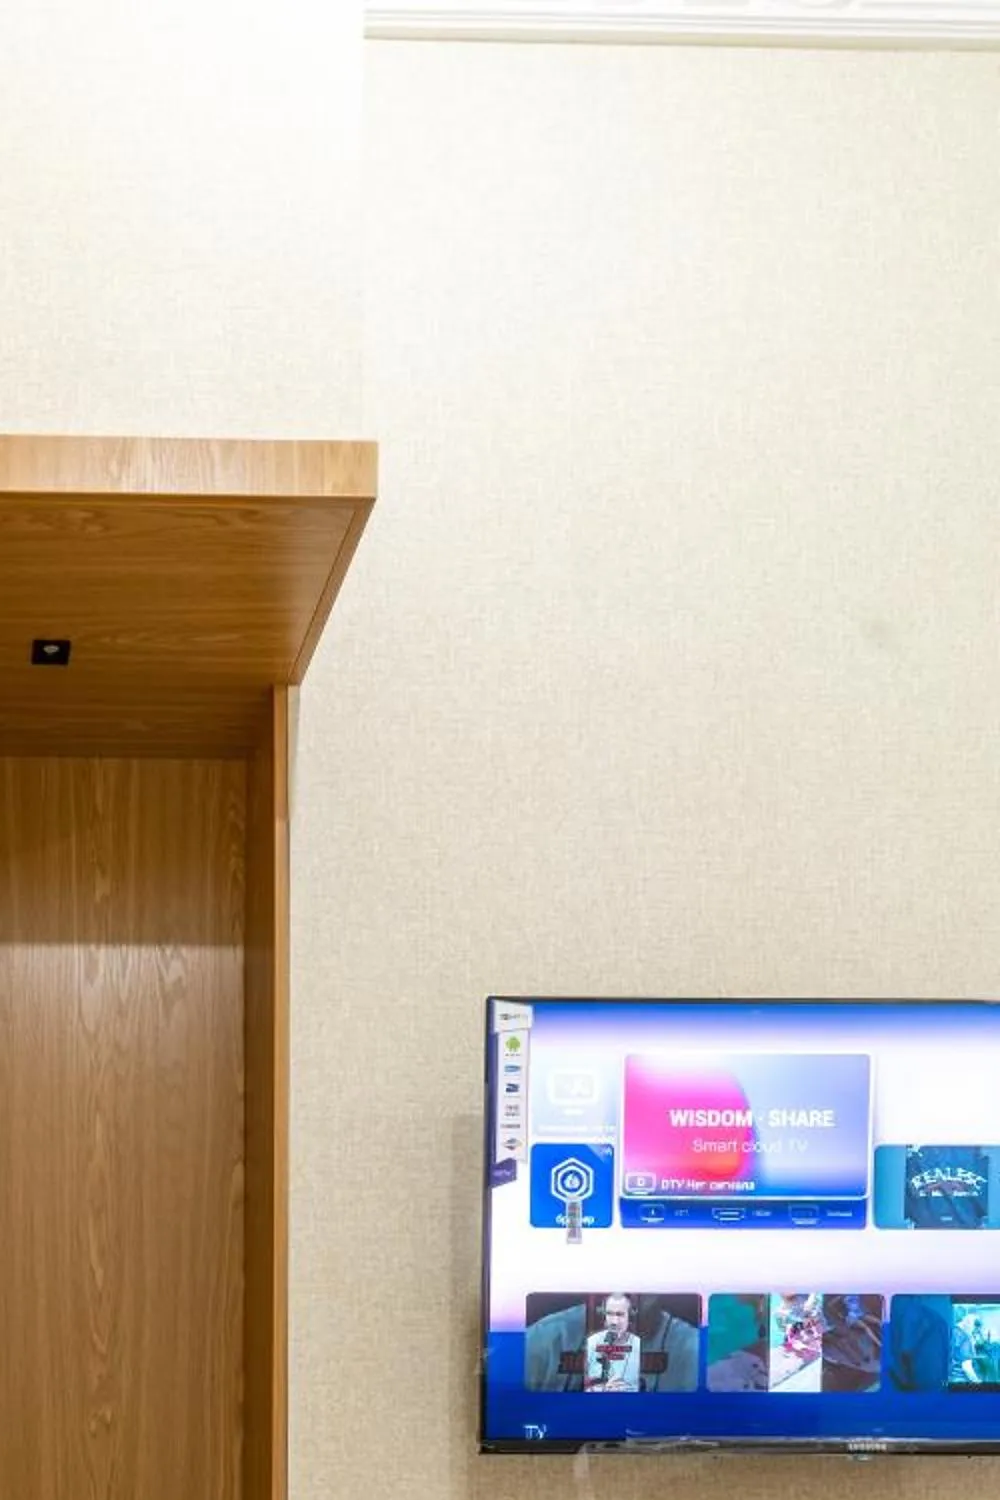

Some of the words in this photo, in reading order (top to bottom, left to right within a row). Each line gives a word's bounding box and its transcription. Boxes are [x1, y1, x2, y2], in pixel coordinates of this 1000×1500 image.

[669, 1109, 752, 1127] WISDOM
[768, 1109, 835, 1127] SHARE
[692, 1138, 737, 1153] Smart
[742, 1138, 782, 1153] cloud
[789, 1138, 808, 1153] TV
